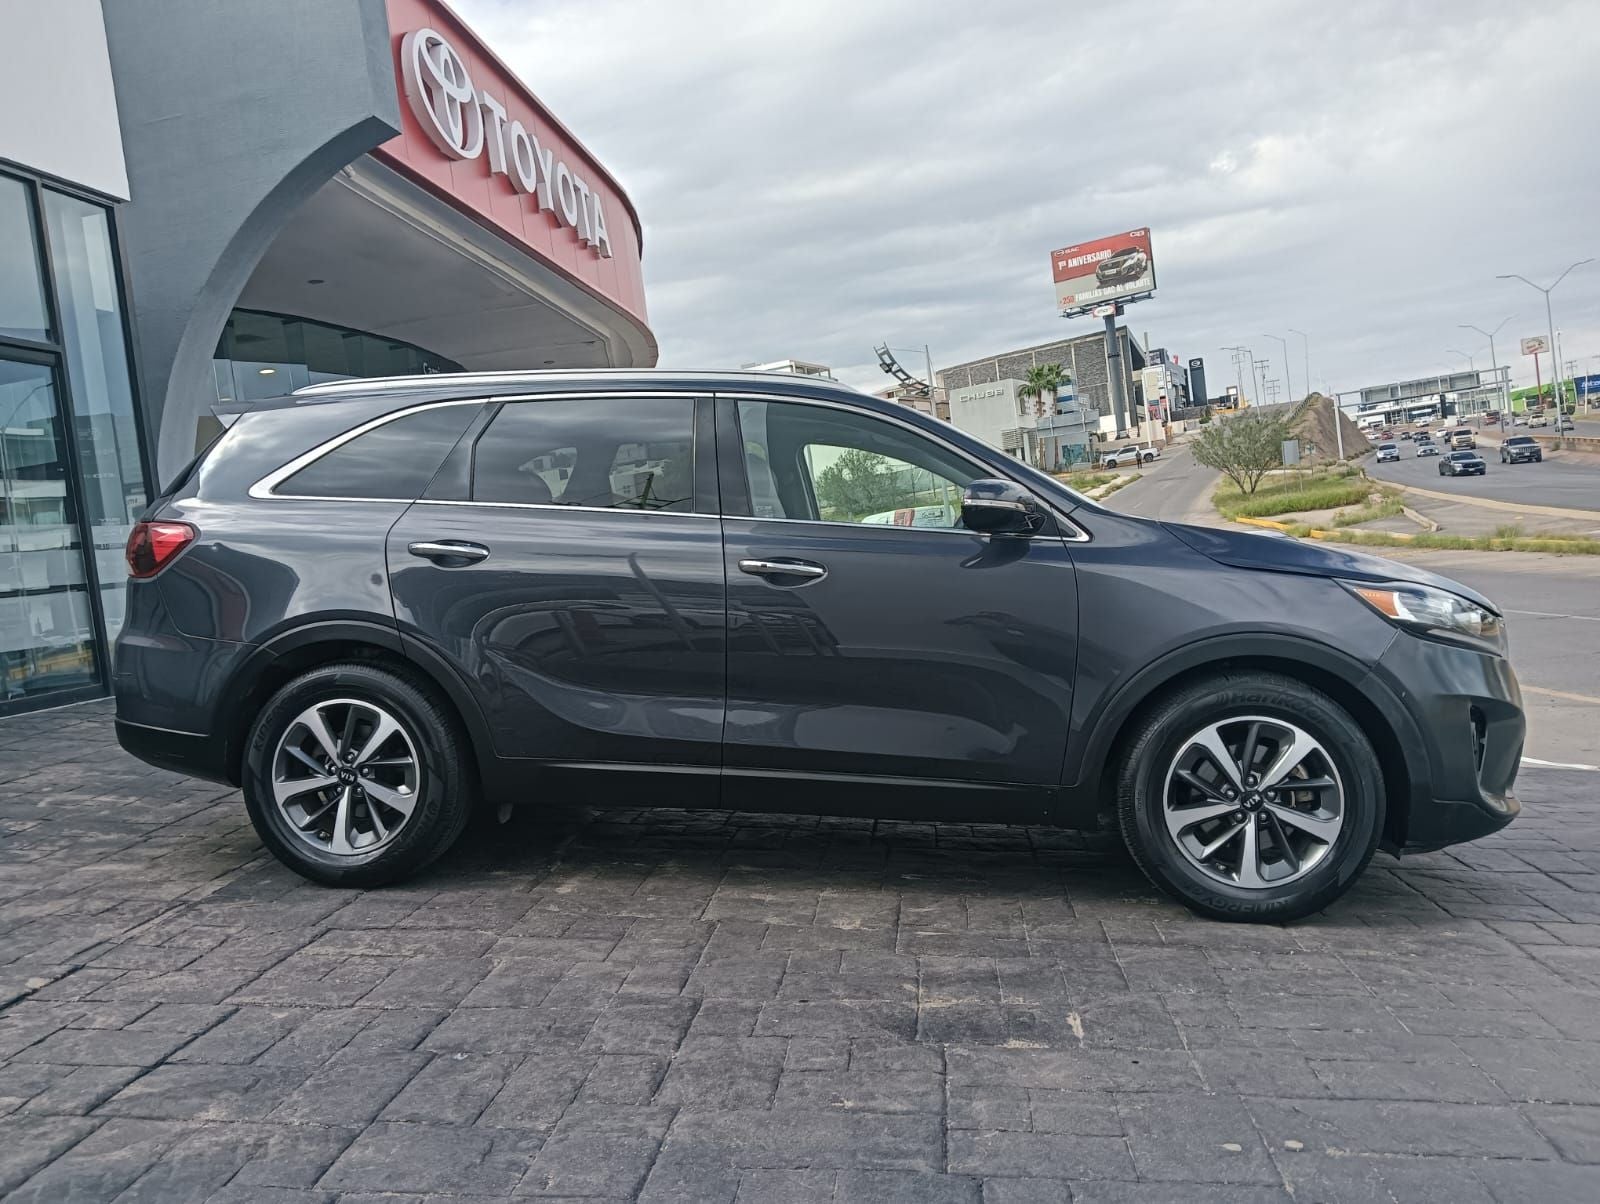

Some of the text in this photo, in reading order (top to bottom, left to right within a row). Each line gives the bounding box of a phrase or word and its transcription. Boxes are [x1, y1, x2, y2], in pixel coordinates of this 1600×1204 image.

[479, 91, 612, 259] TOYOTA
[1068, 249, 1112, 268] ANIVERSARIO
[340, 771, 355, 781] KIA
[1243, 794, 1260, 808] KIA
